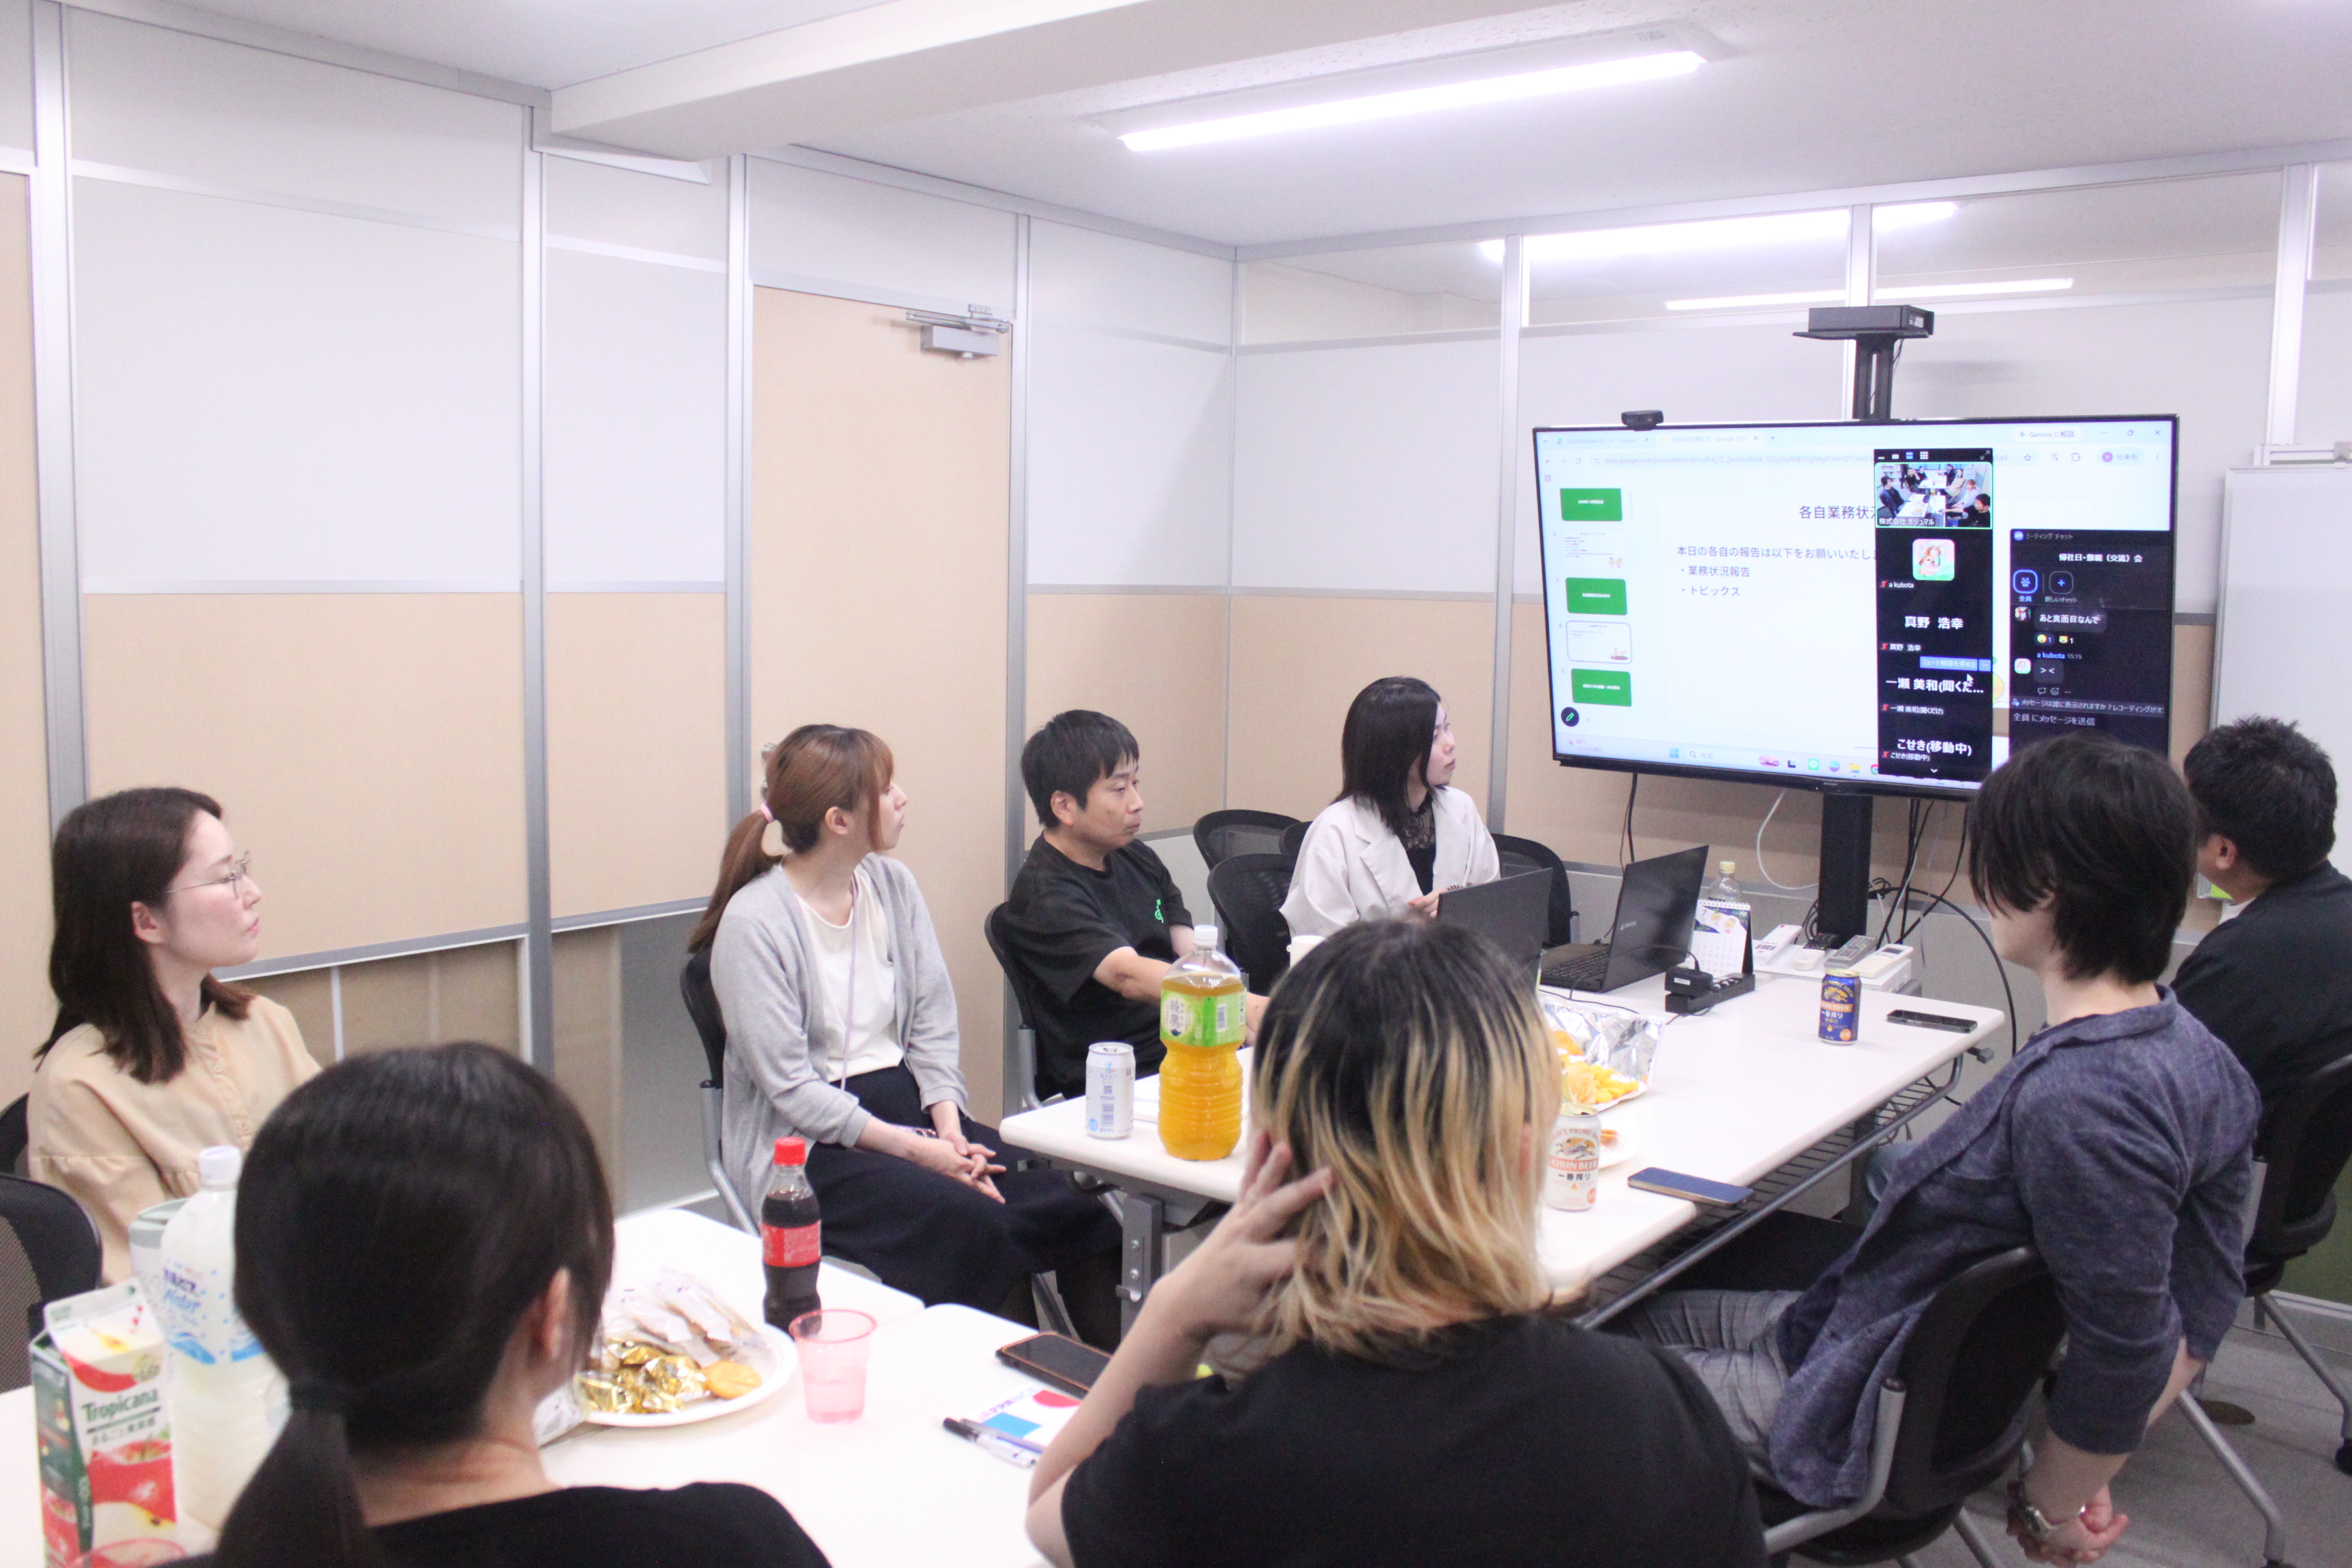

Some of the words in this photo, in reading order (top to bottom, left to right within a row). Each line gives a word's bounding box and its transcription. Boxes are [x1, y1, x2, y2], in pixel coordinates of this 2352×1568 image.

[1904, 615, 1930, 629] 真野
[1938, 617, 1963, 630] 浩幸
[2039, 615, 2100, 624] あと真面目なんで
[1889, 643, 1904, 651] 真野
[1886, 677, 1910, 689] 一瀬
[2012, 713, 2029, 722] 全員
[2031, 715, 2095, 726] にメッセージを送信
[1897, 738, 1972, 757] こせき(移動中)
[1890, 752, 1930, 762] こせき(移動中)
[1170, 998, 1180, 1028] 綾鷹
[1552, 1159, 1578, 1170] KIRIN
[1579, 1160, 1598, 1169] BEER
[1558, 1173, 1590, 1181] 一番搾り
[80, 1389, 158, 1422] Tropicana
